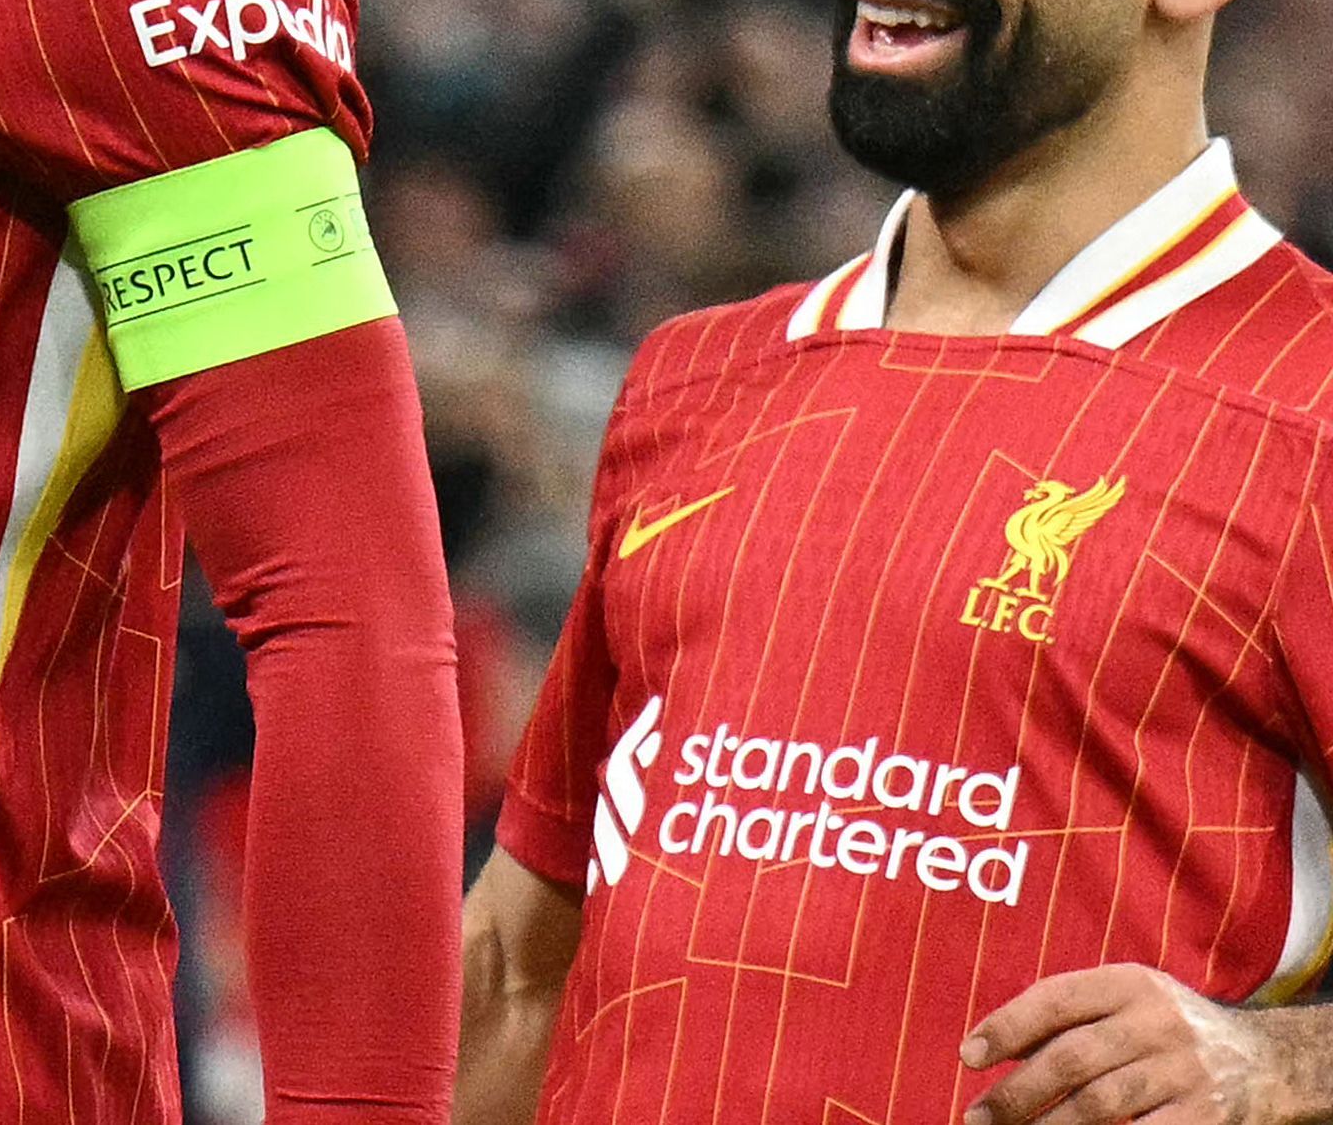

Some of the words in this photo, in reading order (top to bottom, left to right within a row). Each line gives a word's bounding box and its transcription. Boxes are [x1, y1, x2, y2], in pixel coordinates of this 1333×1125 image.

[102, 238, 253, 315] RESPECT
[673, 723, 1021, 831] standard
[658, 791, 1029, 907] chartered
